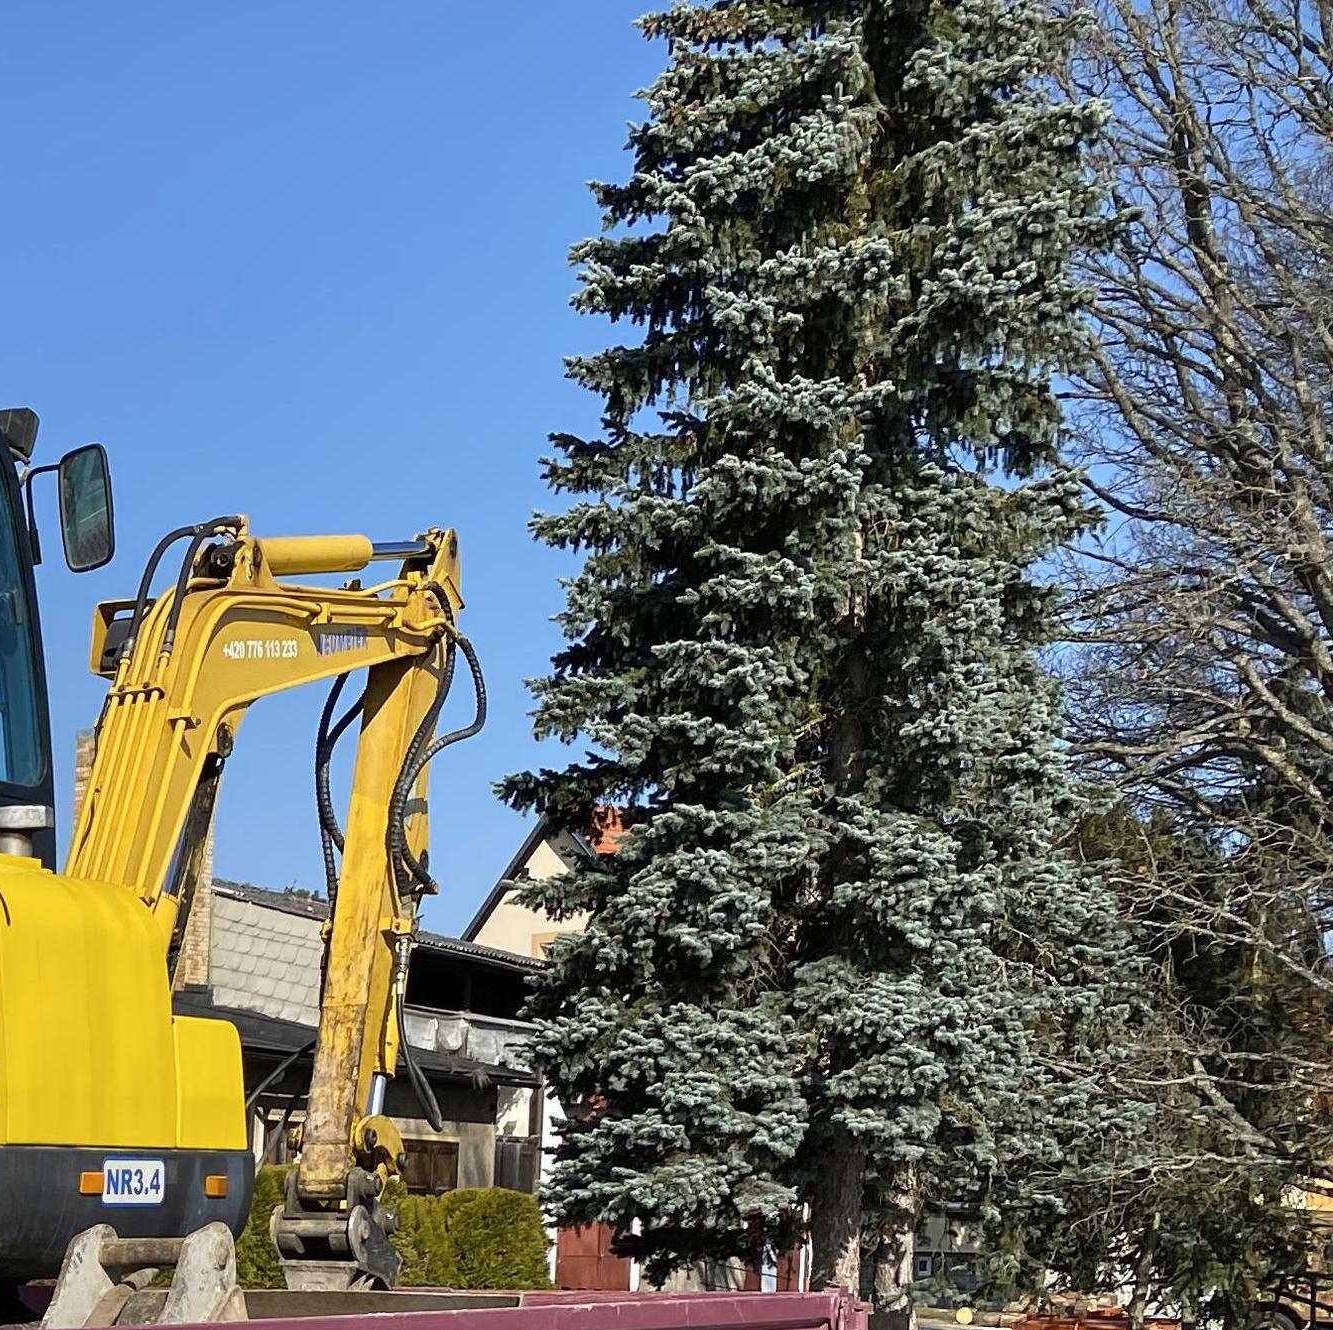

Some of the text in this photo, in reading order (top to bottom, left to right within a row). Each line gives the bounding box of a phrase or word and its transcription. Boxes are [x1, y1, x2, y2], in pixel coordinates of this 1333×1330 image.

[246, 640, 264, 658] 776
[265, 640, 281, 658] 113
[281, 639, 298, 658] 233
